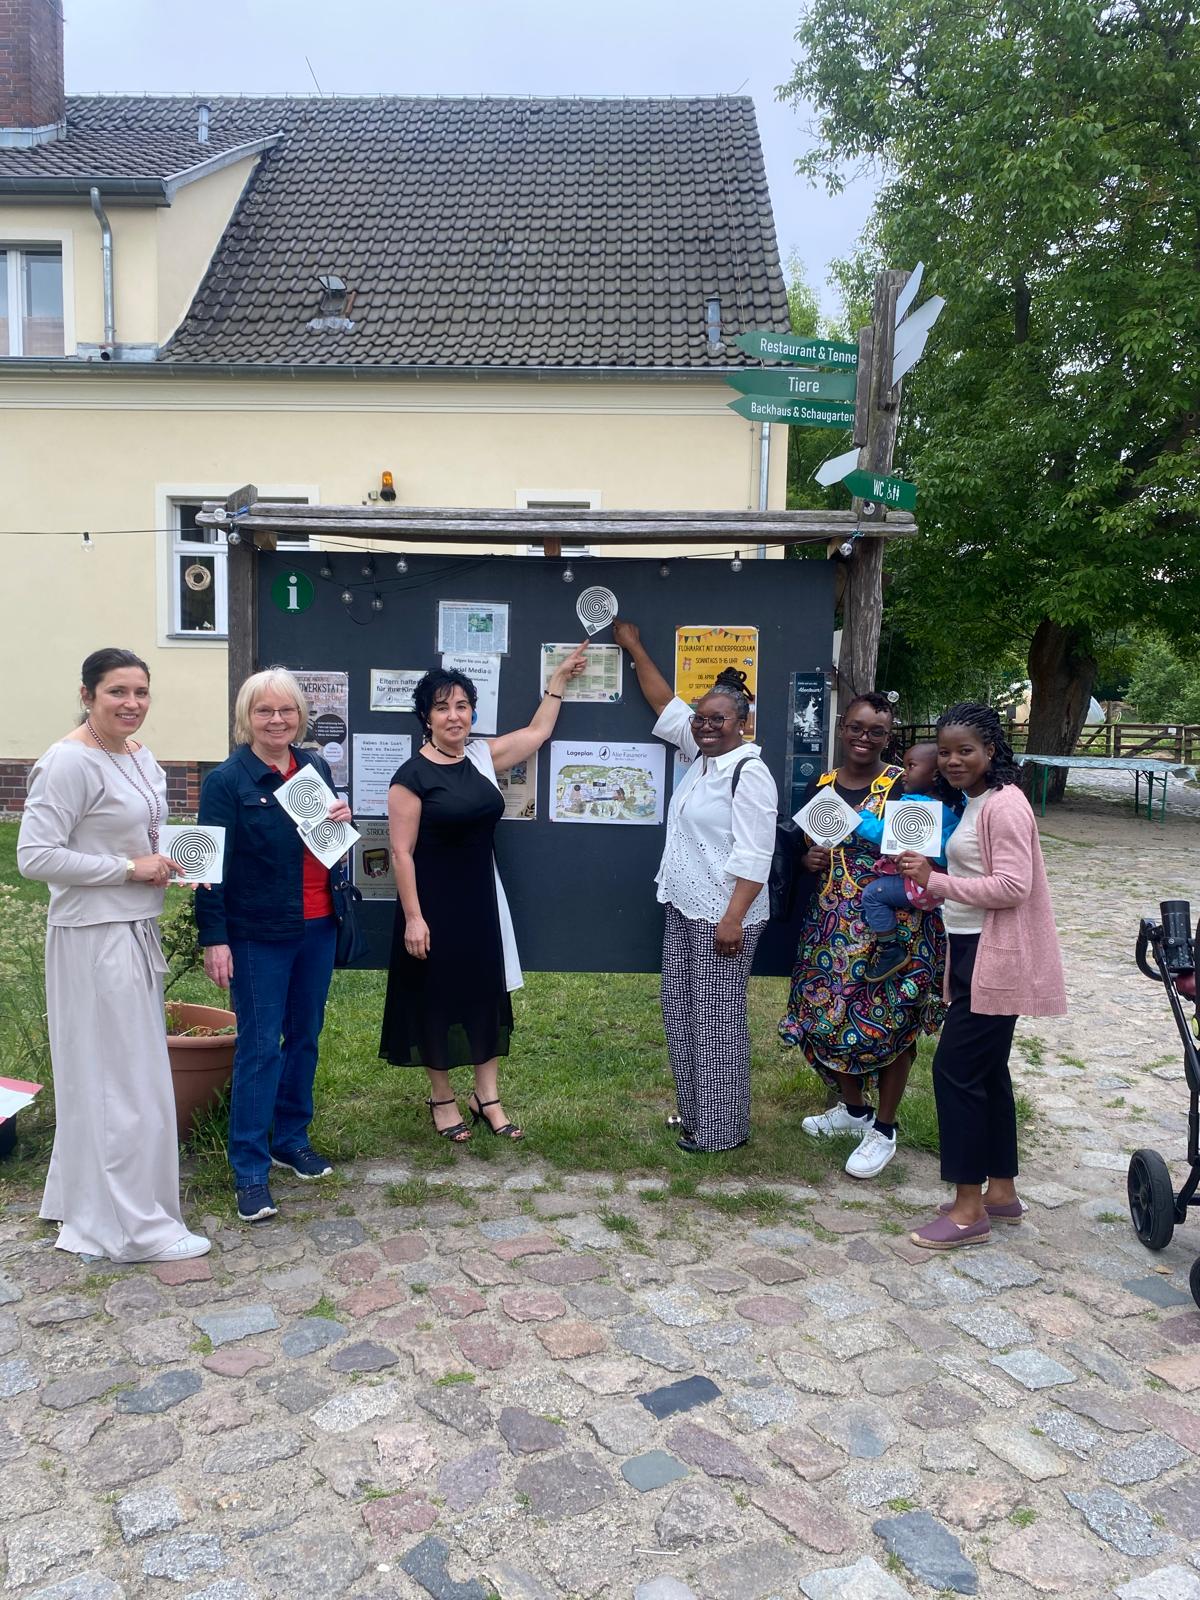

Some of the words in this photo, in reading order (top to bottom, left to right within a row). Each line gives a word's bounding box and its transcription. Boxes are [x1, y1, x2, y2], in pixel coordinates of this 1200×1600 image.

[760, 338, 817, 359] Restaurant
[818, 346, 826, 360] &
[828, 347, 858, 364] Tenne
[788, 376, 820, 393] Tiere
[751, 402, 792, 417] Backhaus
[792, 406, 800, 418] &
[800, 407, 855, 424] Schaugarten
[873, 479, 885, 497] WC
[566, 749, 594, 757] Lageplan
